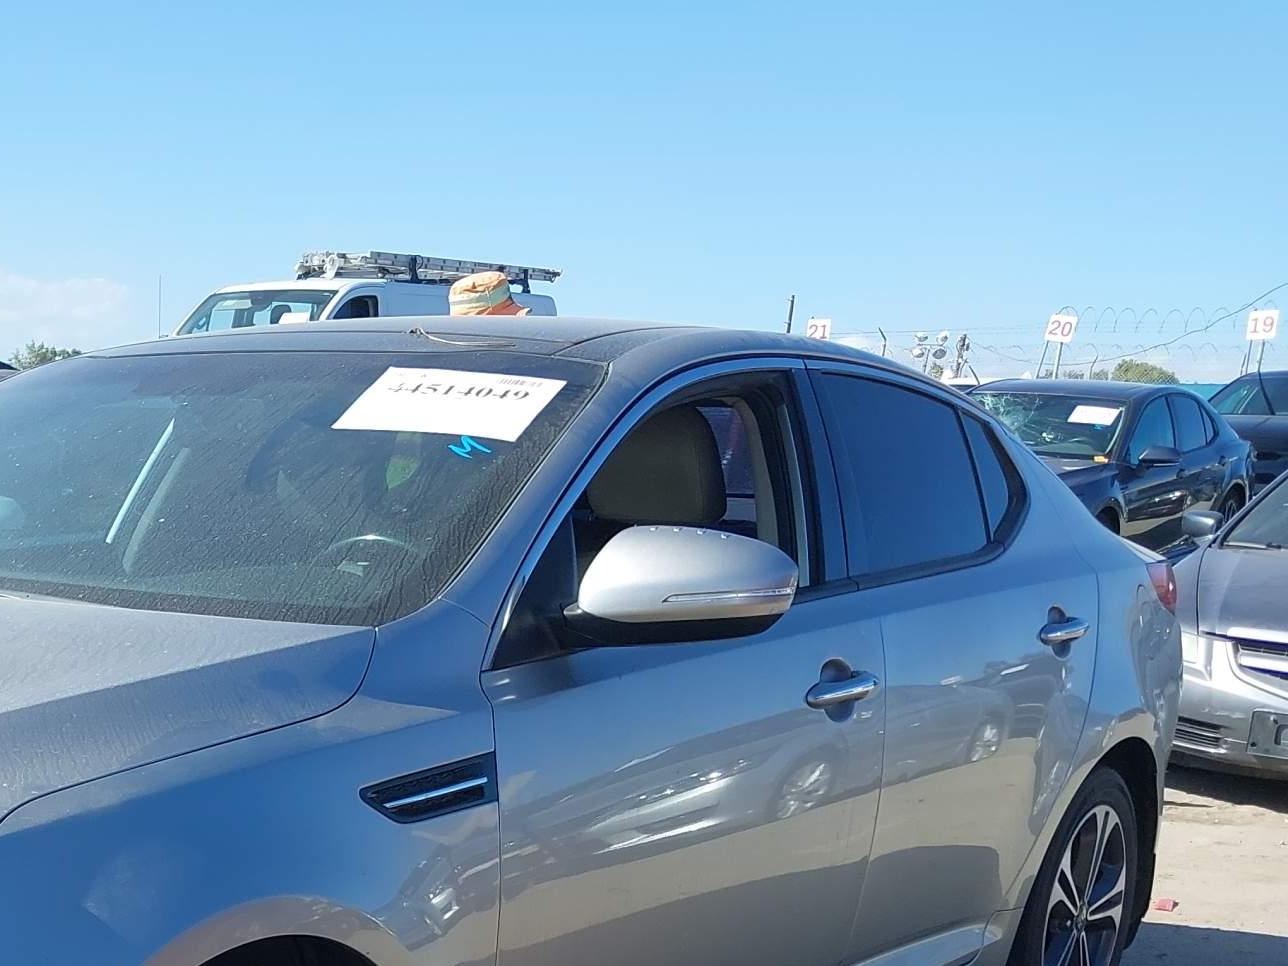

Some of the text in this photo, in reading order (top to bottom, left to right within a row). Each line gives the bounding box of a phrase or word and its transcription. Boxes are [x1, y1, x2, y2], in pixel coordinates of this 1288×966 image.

[809, 324, 827, 339] 21
[1048, 320, 1073, 337] 20
[1249, 316, 1274, 333] 19
[388, 382, 530, 400] 44514049
